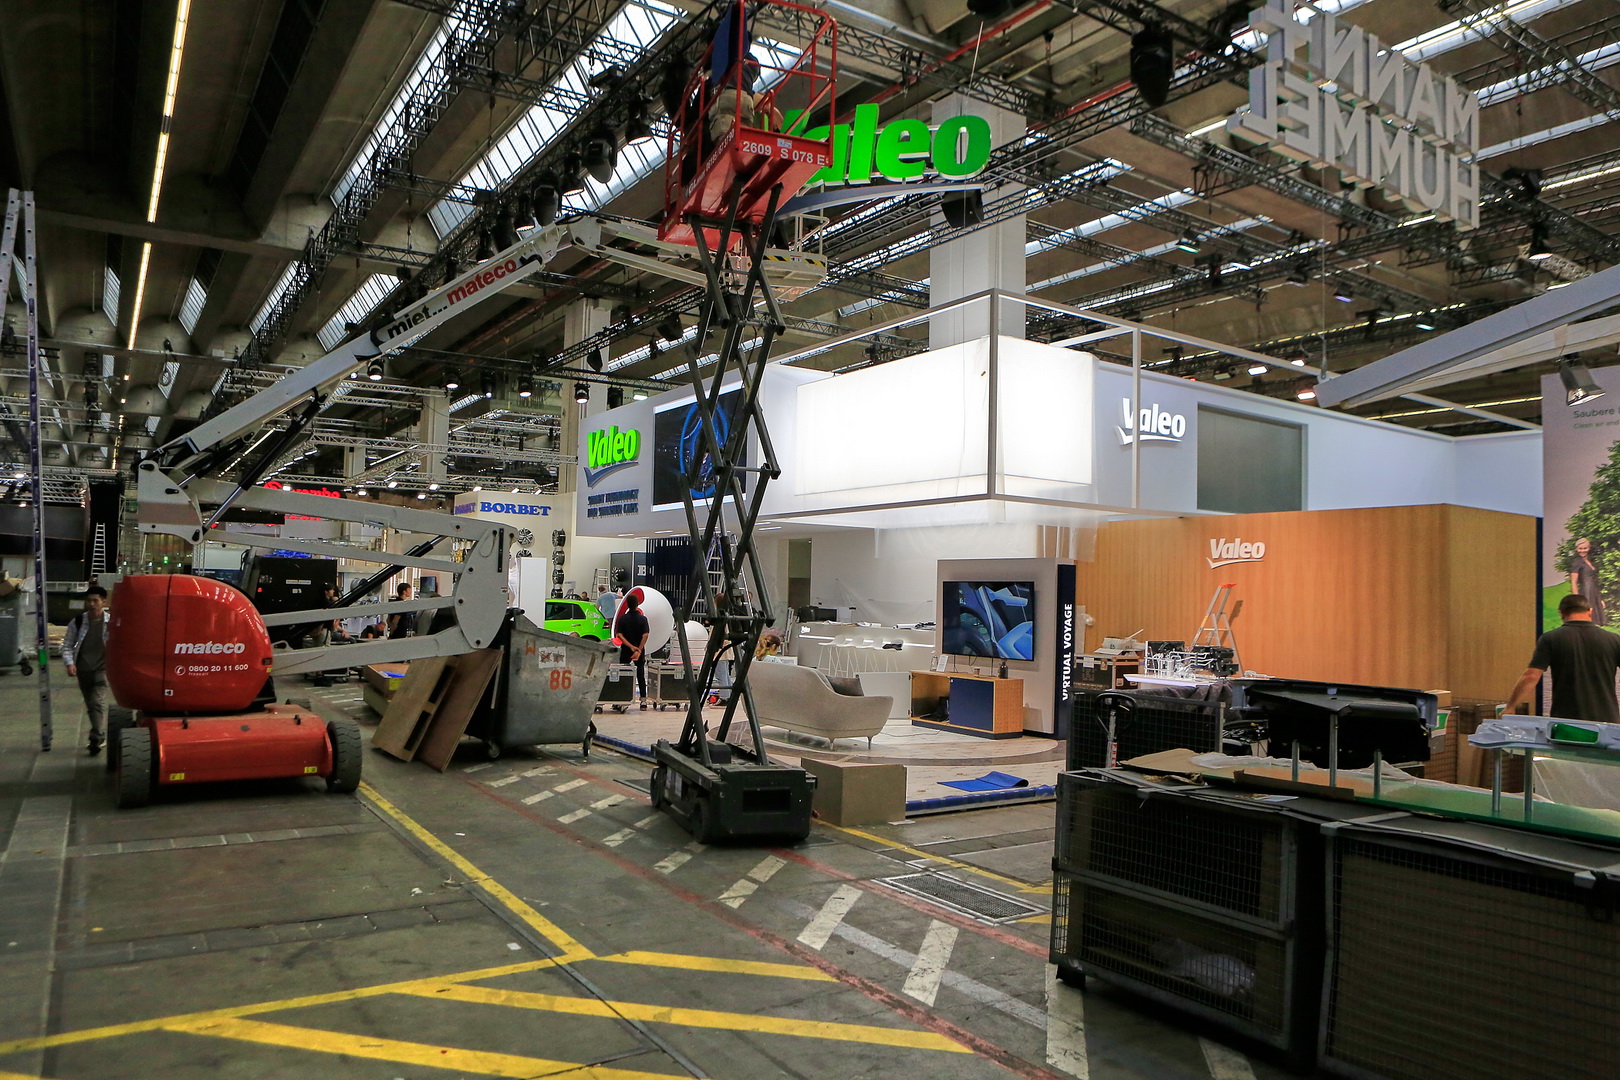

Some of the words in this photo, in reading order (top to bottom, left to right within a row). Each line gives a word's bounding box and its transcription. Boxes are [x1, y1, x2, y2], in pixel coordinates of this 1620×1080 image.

[742, 141, 772, 156] 2609
[780, 148, 789, 160] S
[792, 151, 814, 164] 078
[816, 154, 826, 166] E
[446, 259, 517, 305] mateco
[1573, 408, 1615, 418] Saubere
[587, 425, 641, 469] Valeo
[480, 501, 552, 516] BORBET
[1210, 538, 1266, 560] Valeo
[1063, 603, 1073, 650] VOYAGE
[174, 640, 246, 655] mateco
[549, 669, 573, 691] 86
